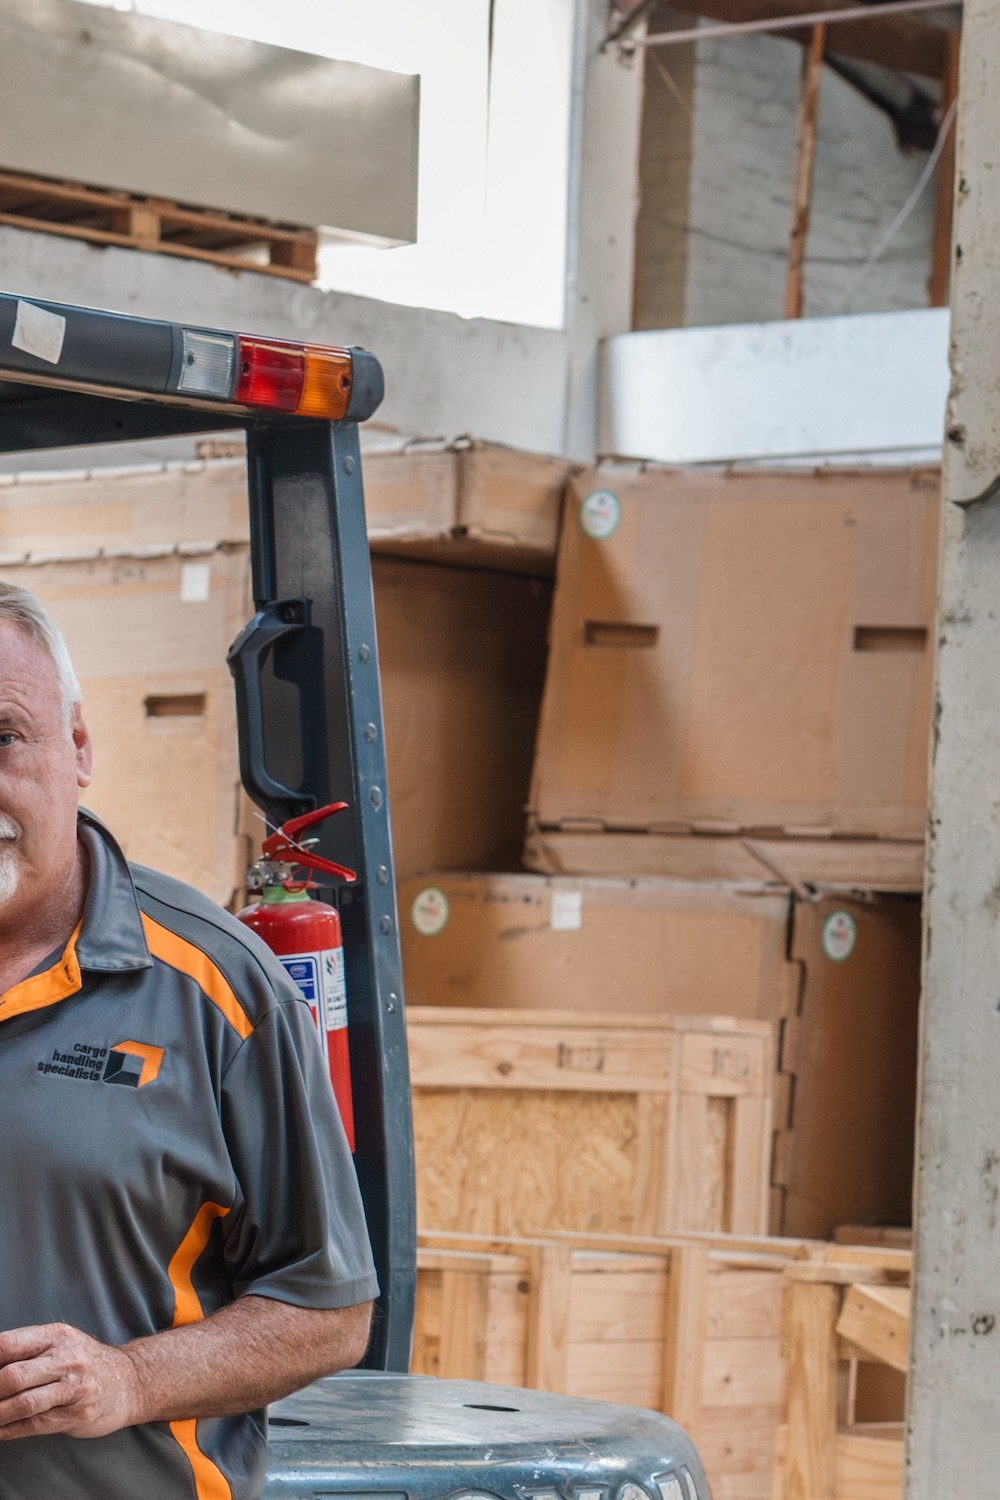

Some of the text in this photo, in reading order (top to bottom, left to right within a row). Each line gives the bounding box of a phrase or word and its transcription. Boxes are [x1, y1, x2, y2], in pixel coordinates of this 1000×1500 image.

[52, 1049, 104, 1071] handling
[73, 1043, 107, 1058] cargo
[37, 1062, 101, 1081] specialists
